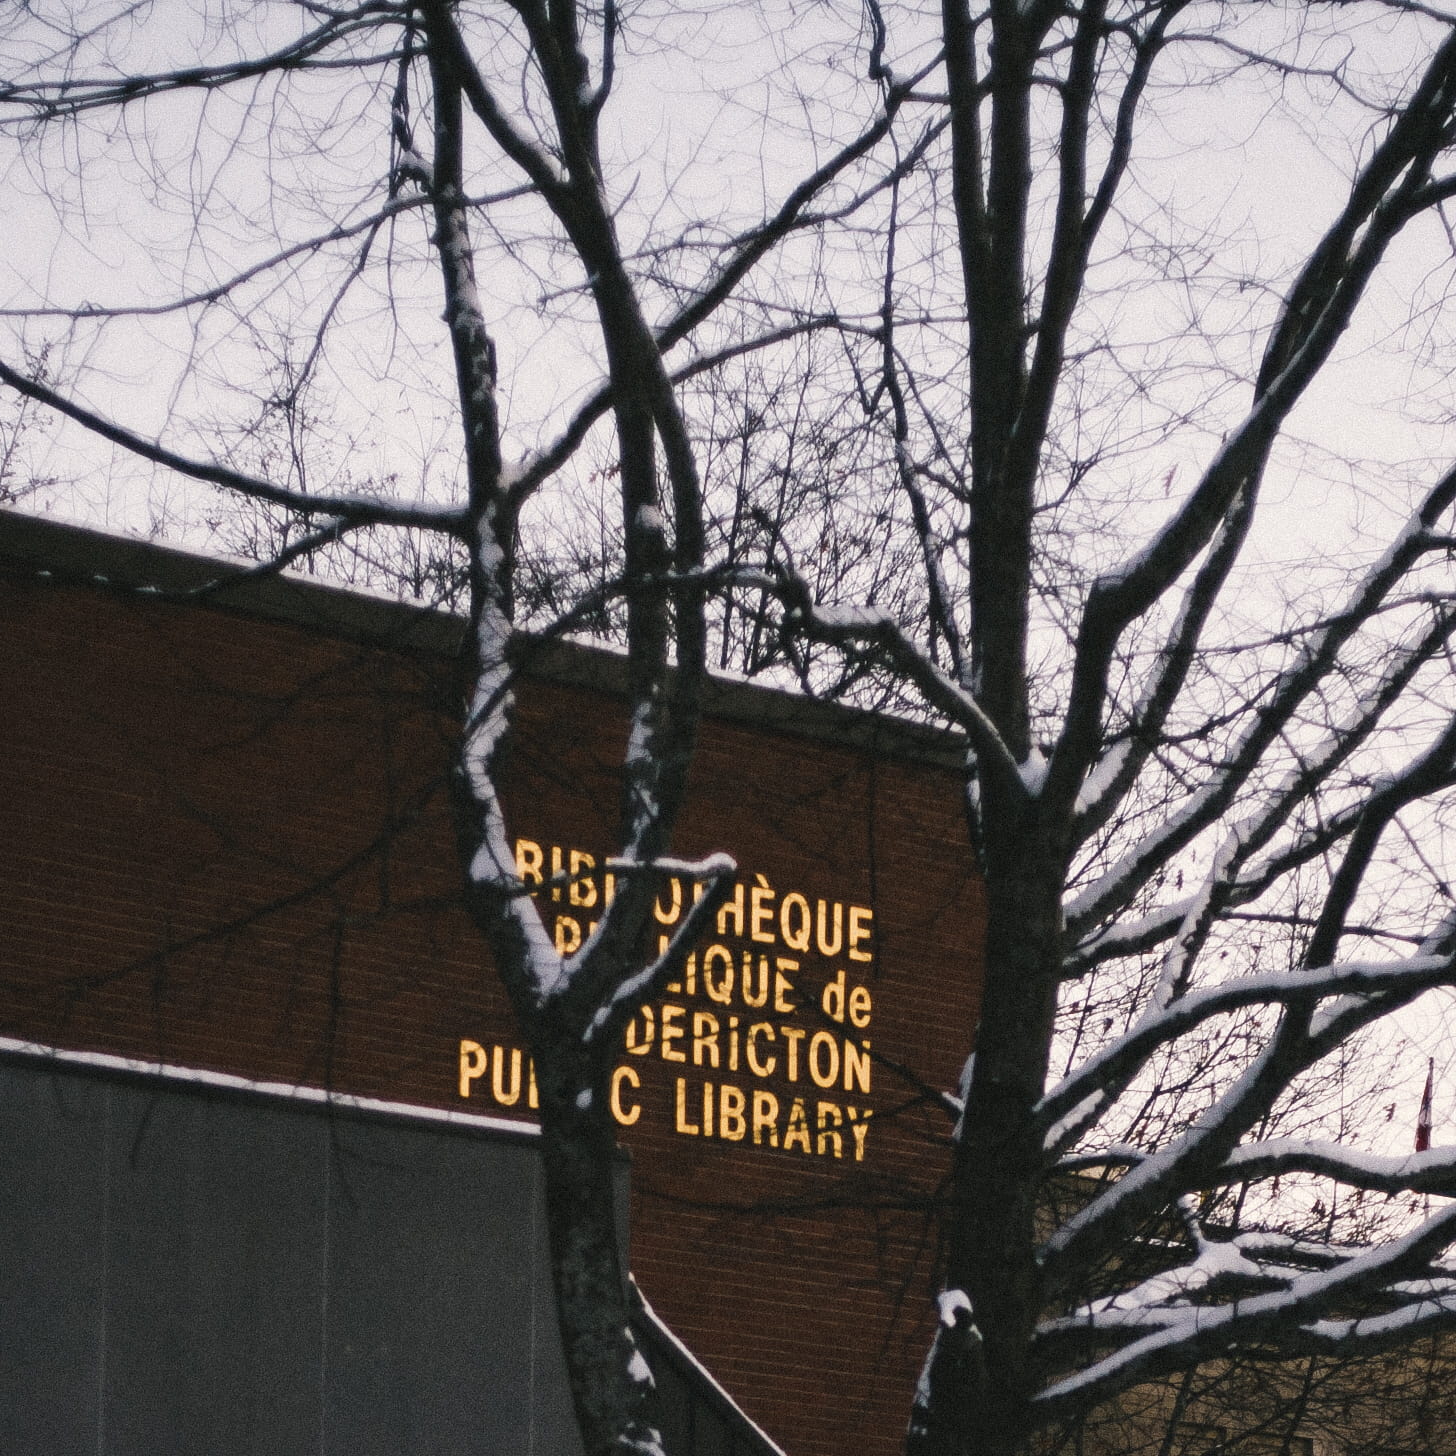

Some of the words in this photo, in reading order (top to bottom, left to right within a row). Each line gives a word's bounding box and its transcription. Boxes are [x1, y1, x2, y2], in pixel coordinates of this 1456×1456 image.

[515, 838, 873, 962] BIBOHÈQUE
[555, 915, 800, 1013] PIQUE
[822, 969, 873, 1028] de
[459, 1039, 642, 1126] PUC
[675, 1077, 873, 1162] LIBRARY
[625, 1004, 872, 1094] DERICTON
